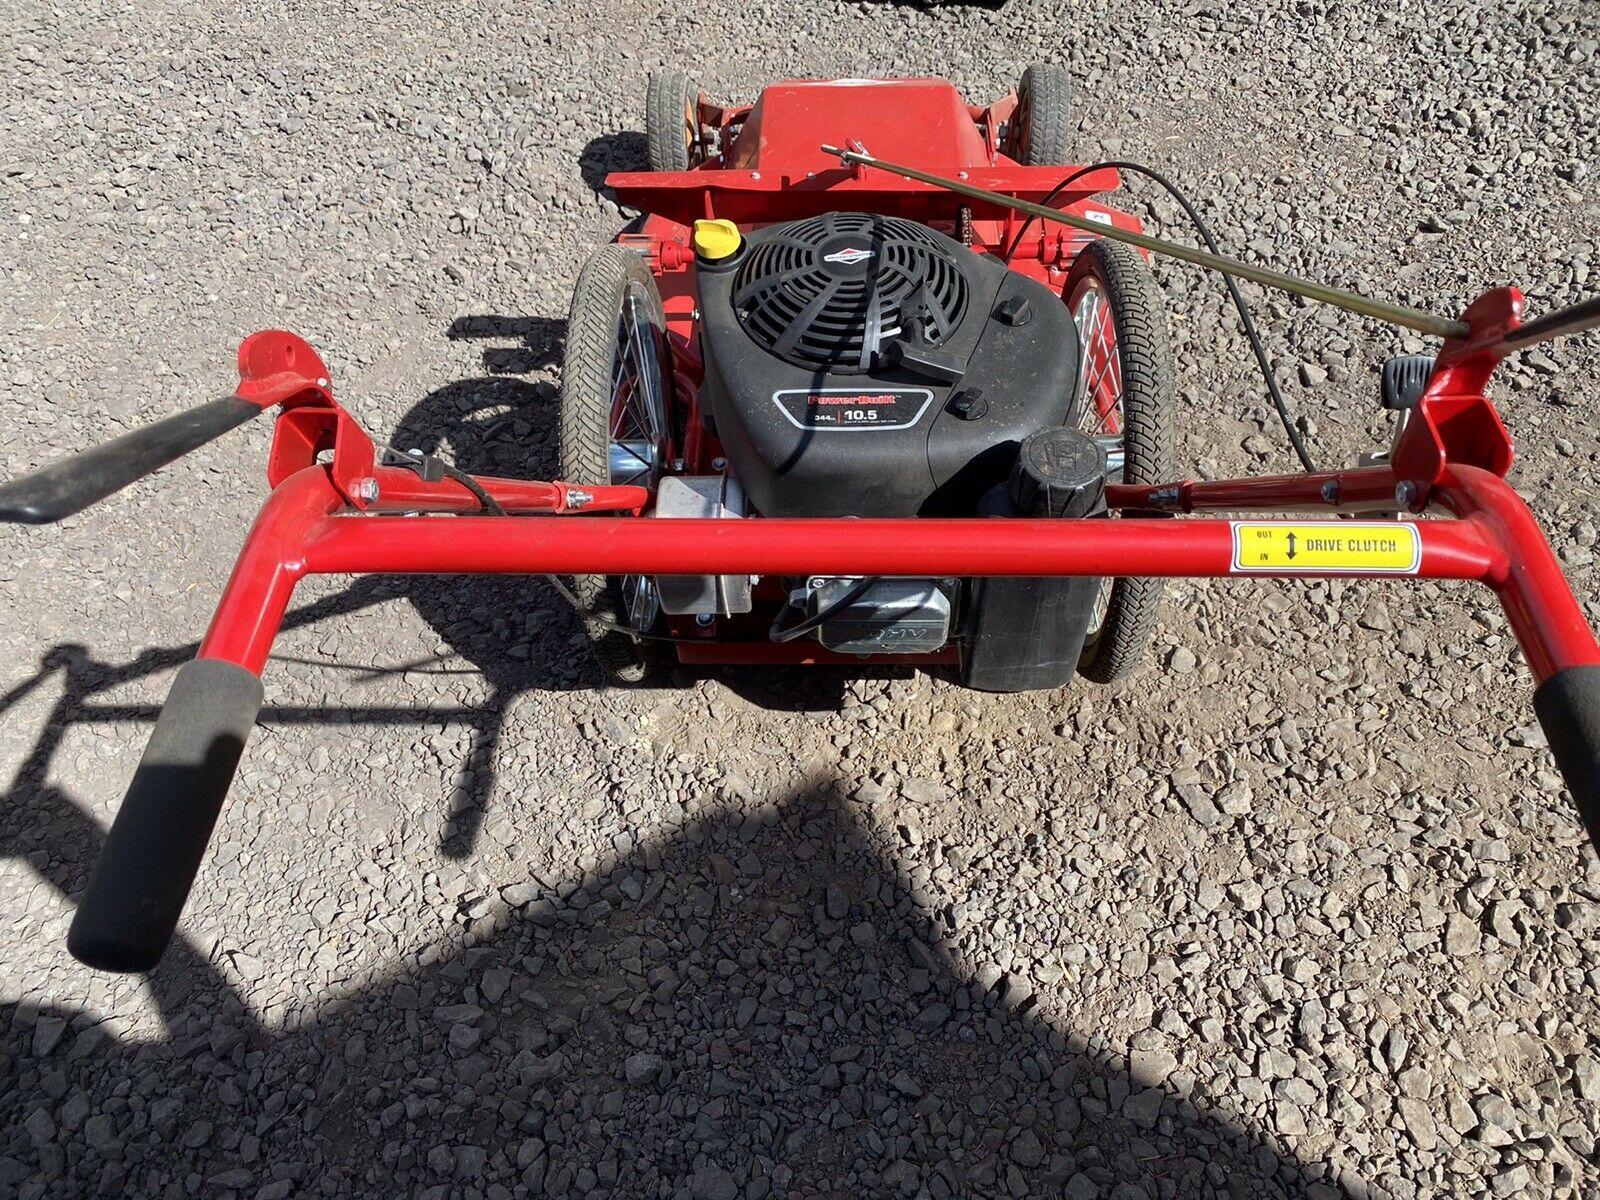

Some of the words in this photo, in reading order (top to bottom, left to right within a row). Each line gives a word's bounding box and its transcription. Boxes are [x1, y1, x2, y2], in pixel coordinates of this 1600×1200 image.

[844, 410, 878, 420] 10.5
[1306, 539, 1343, 552] DRIVE
[1349, 539, 1397, 552] CLUTCH
[1259, 552, 1269, 561] IN
